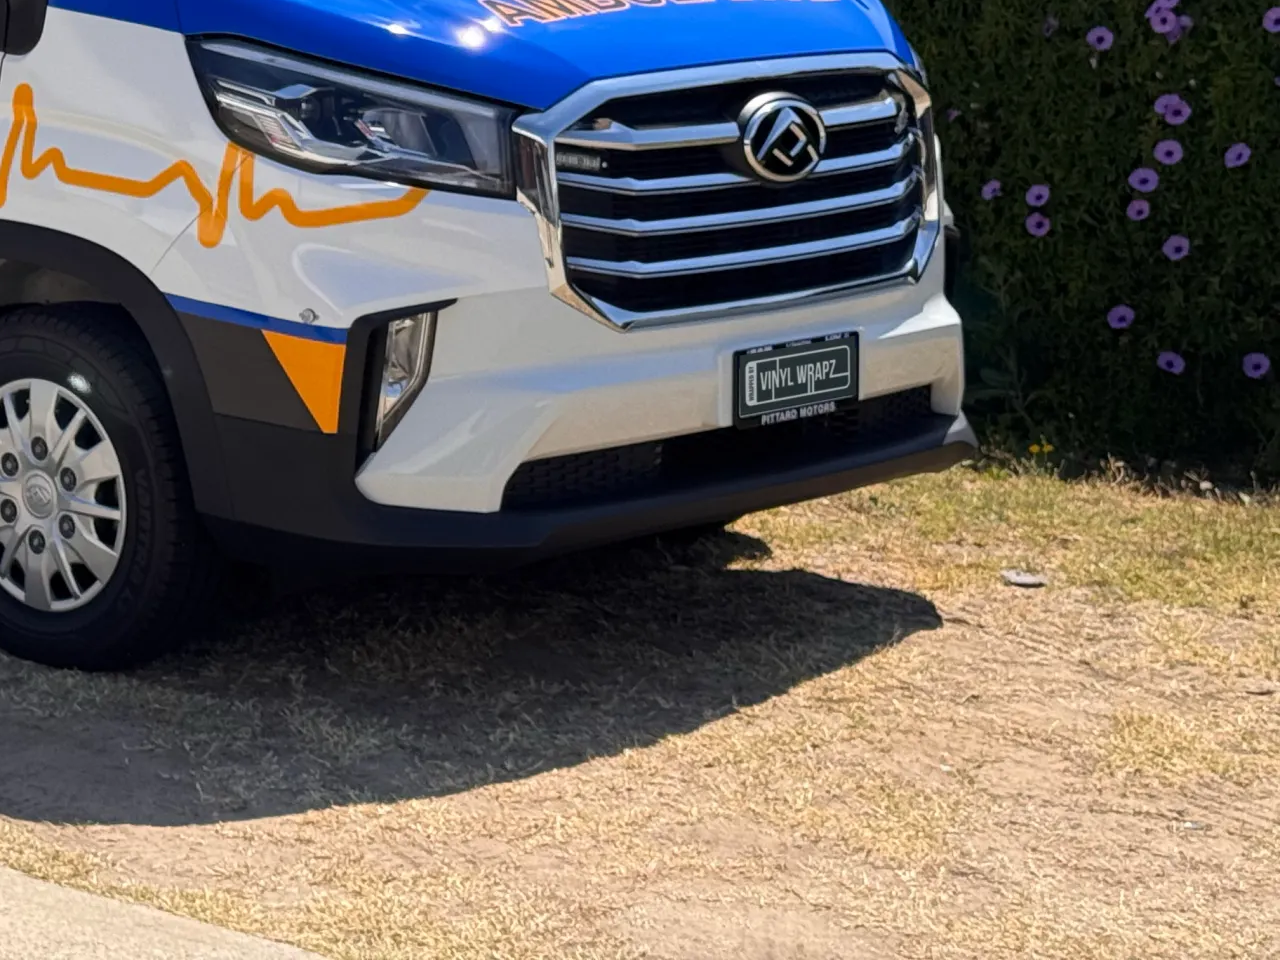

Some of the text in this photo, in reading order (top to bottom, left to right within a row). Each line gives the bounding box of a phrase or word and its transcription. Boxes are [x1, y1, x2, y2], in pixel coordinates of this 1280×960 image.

[760, 359, 837, 391] VINYL WRAPZ
[761, 401, 837, 426] PITTARO MOTORS
